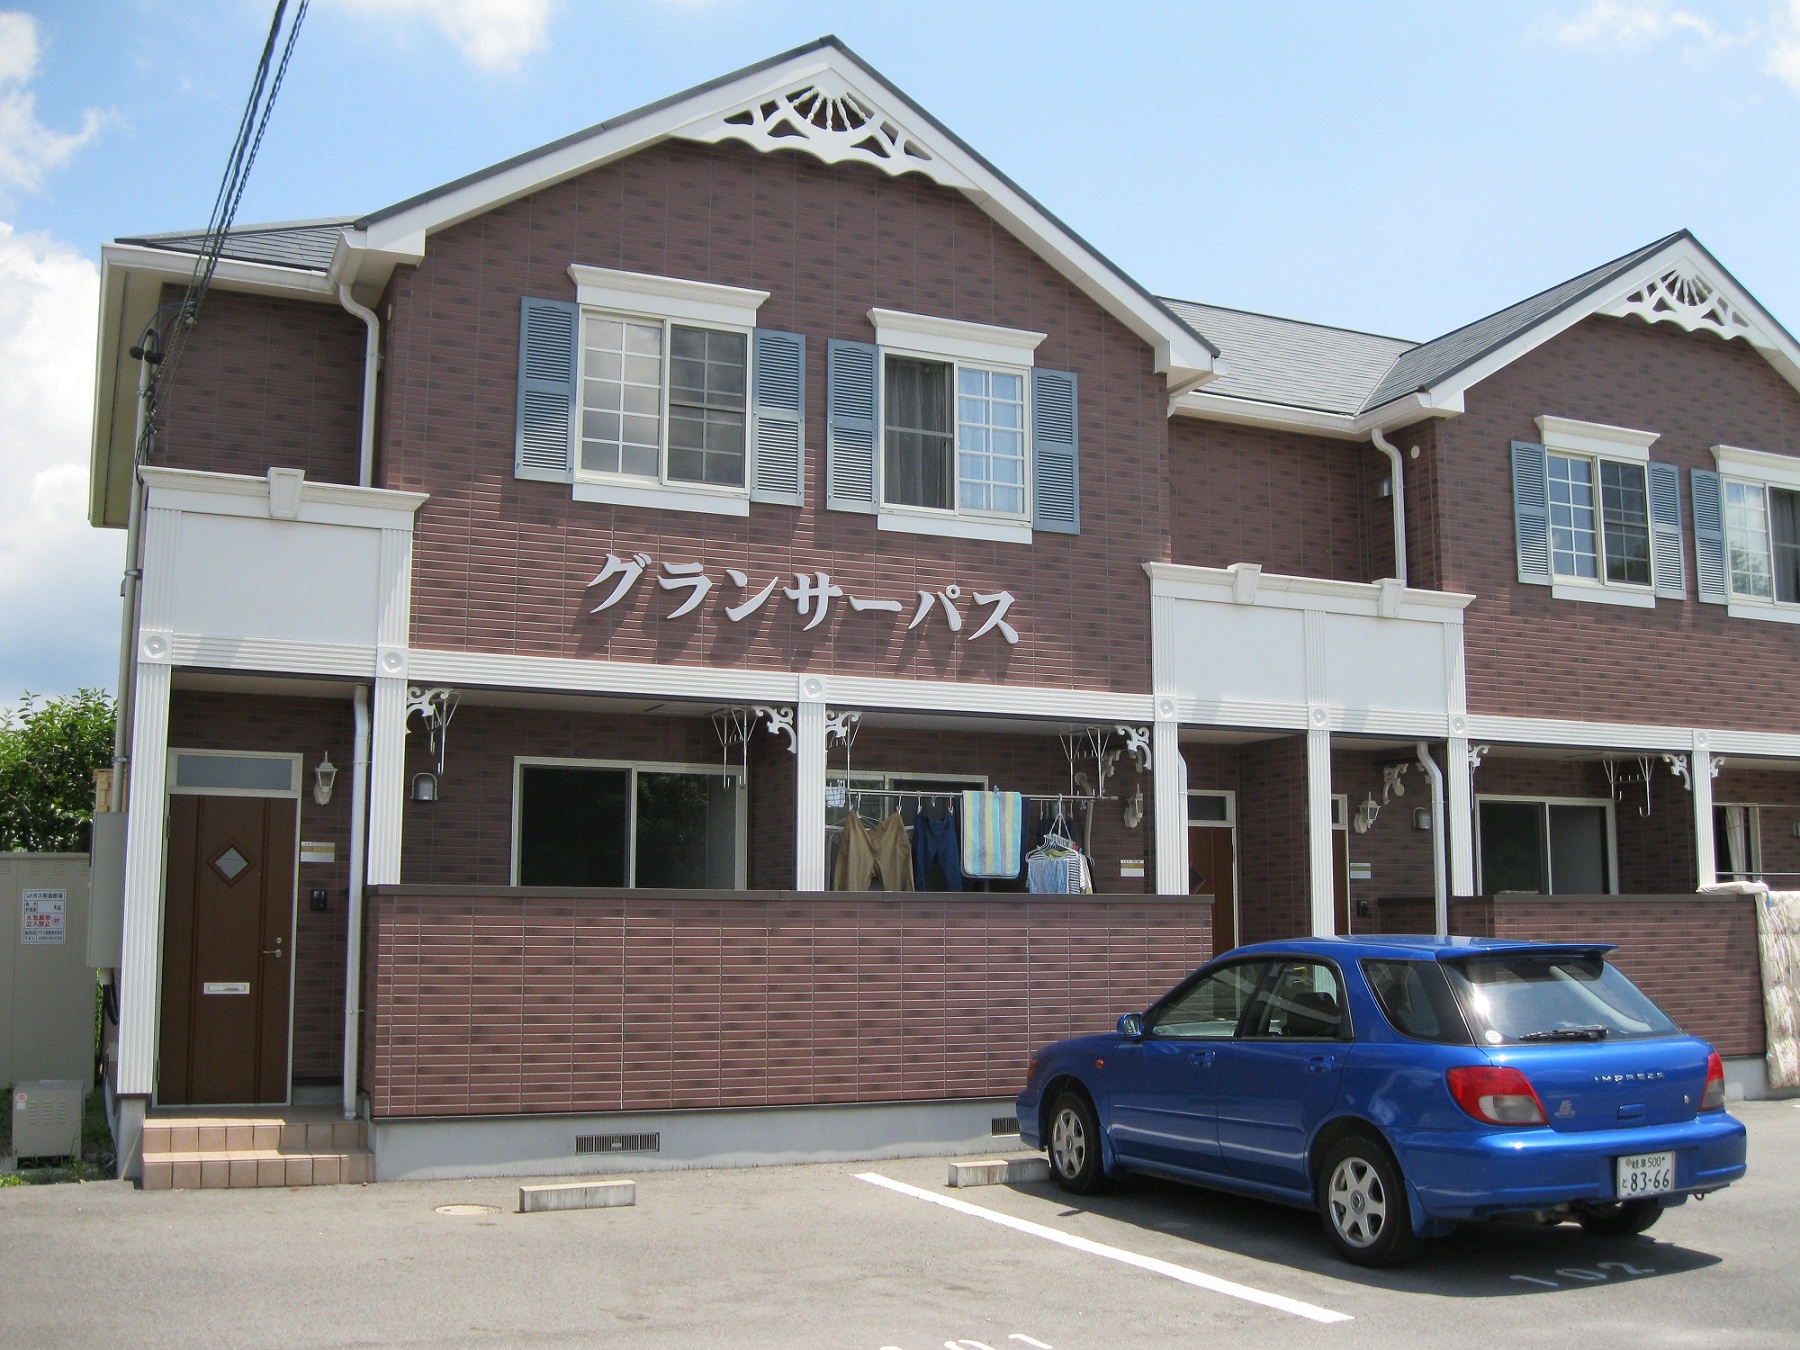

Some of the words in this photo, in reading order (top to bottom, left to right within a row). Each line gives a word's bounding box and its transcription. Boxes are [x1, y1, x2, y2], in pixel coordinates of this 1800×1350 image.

[587, 552, 1019, 644] グランサーパス
[1621, 1178, 1628, 1189] と
[1509, 1261, 1656, 1288] 102
